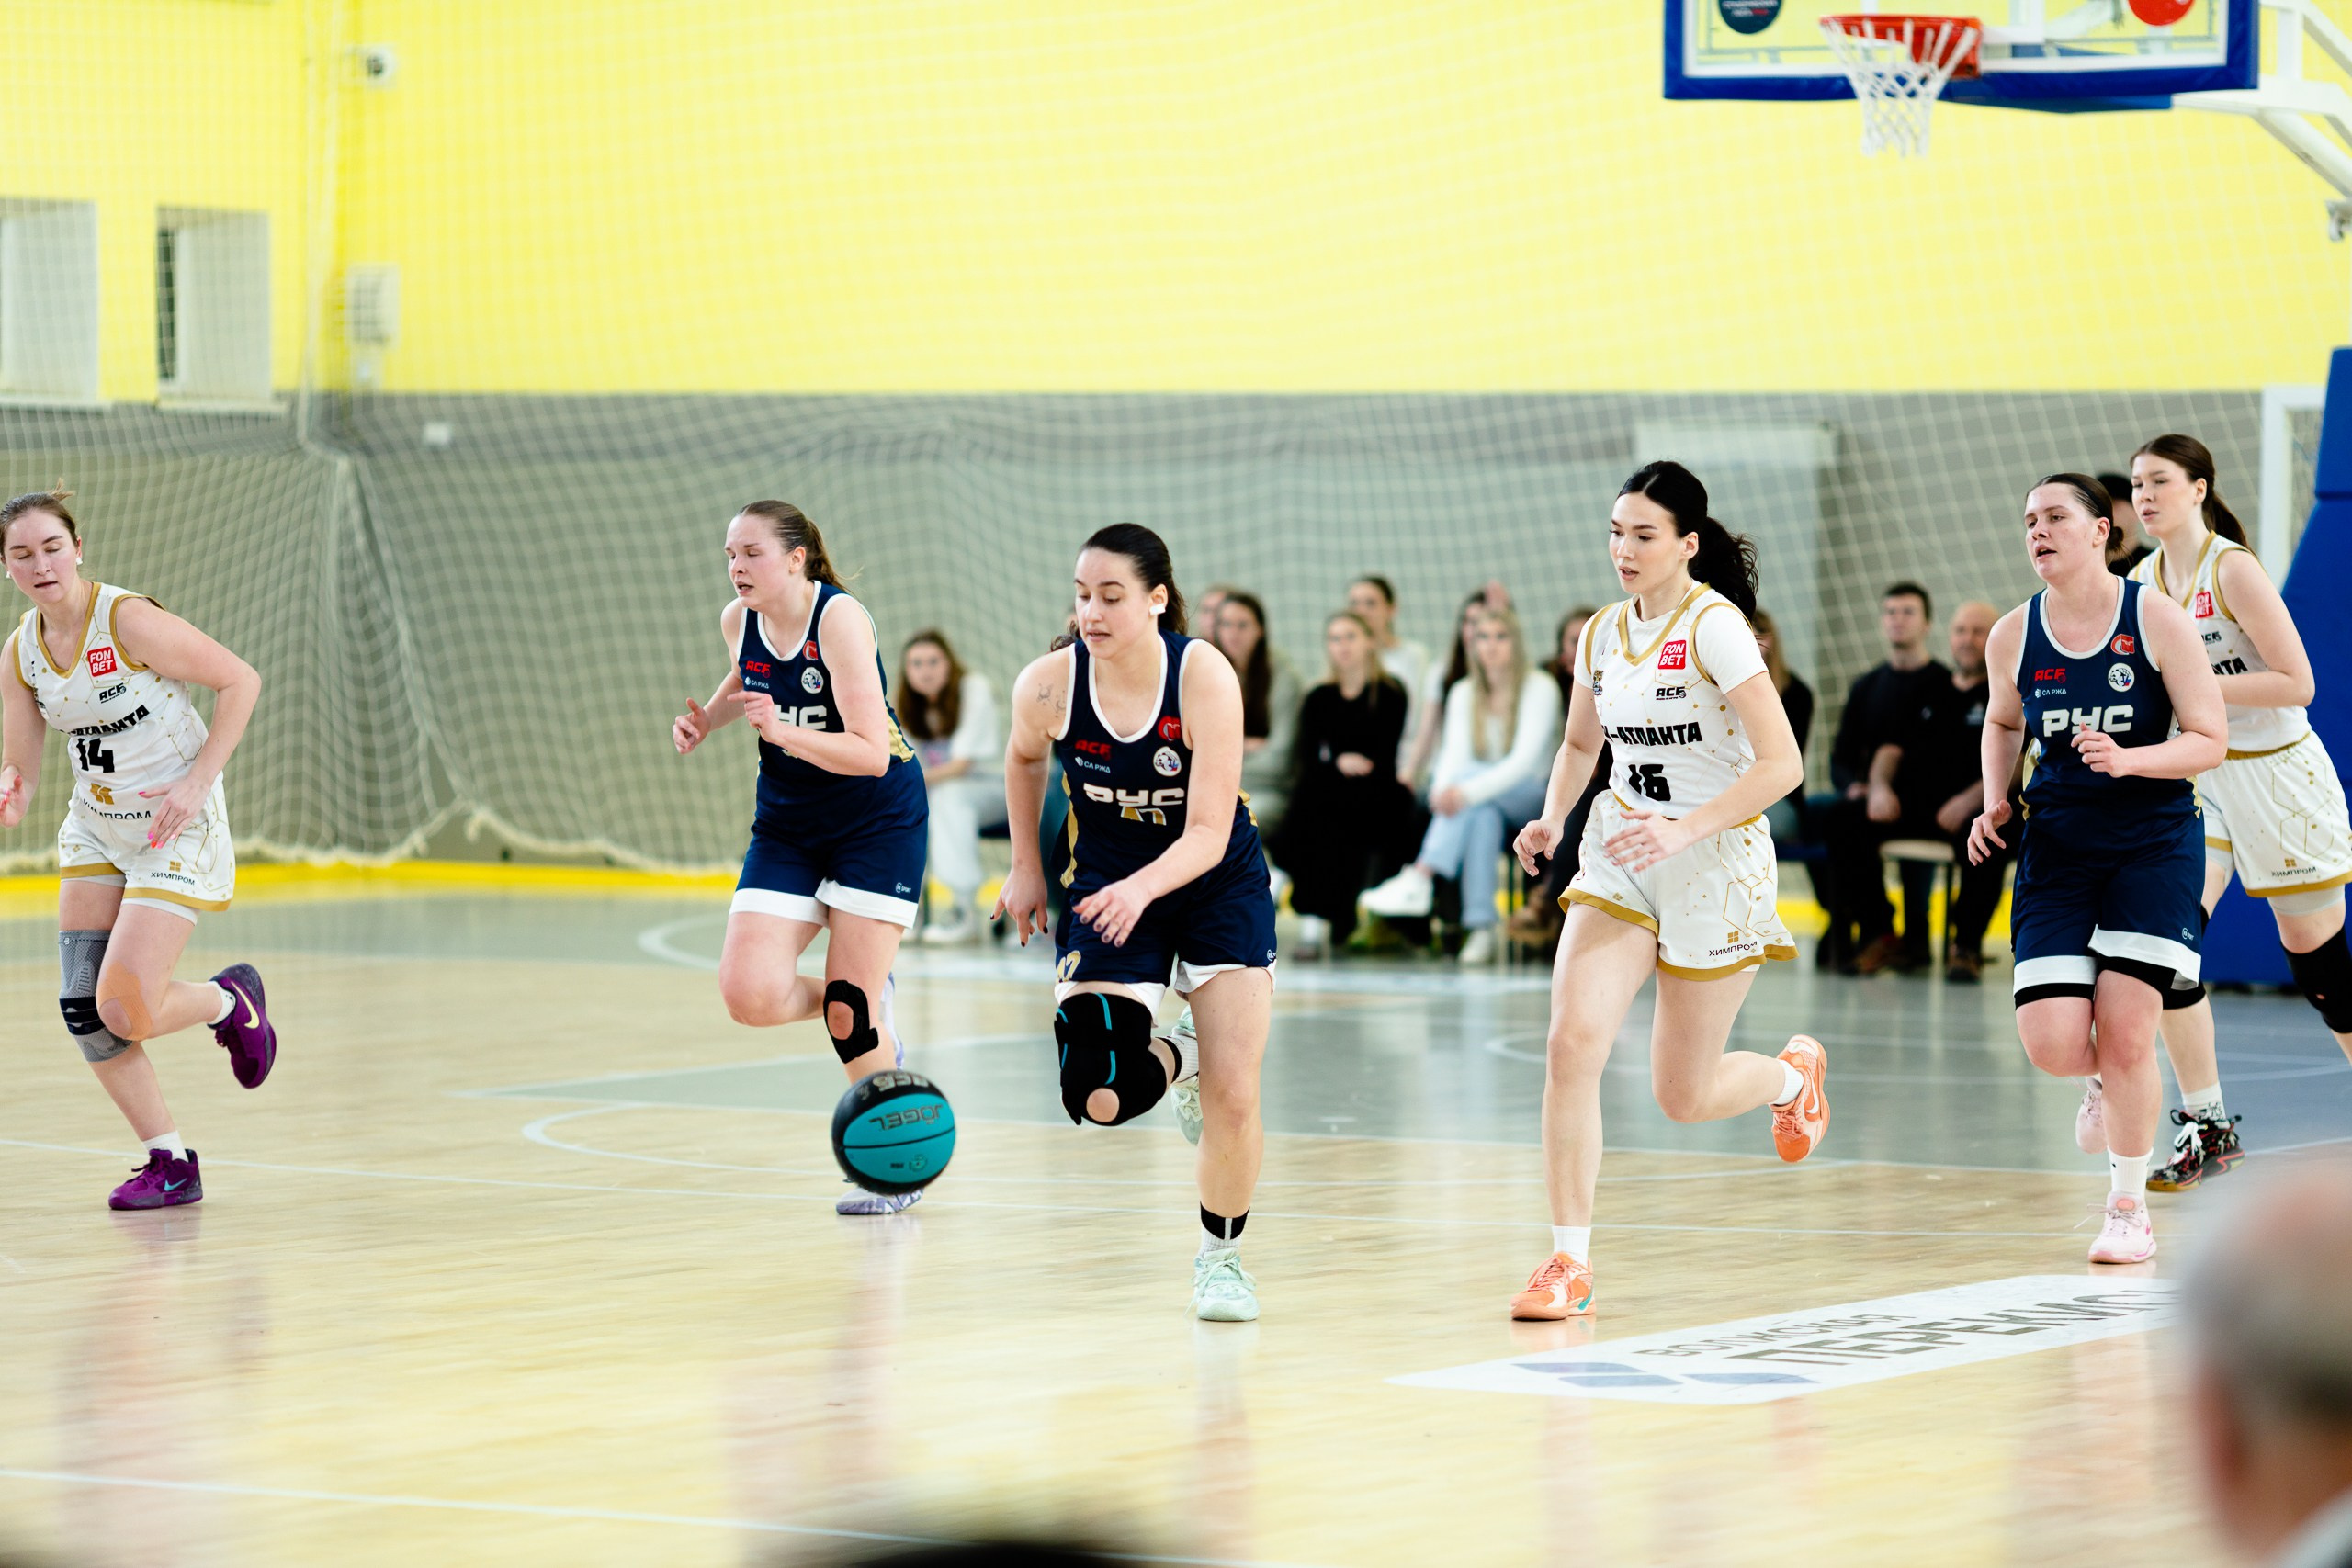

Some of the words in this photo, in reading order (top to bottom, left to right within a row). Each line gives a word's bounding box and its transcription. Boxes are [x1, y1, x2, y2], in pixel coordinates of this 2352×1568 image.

[2201, 631, 2222, 642] СБ
[90, 649, 111, 663] FON
[1663, 643, 1685, 655] FON
[92, 660, 113, 674] BET
[1659, 654, 1684, 666] BET
[774, 704, 827, 729] УС
[2042, 705, 2133, 737] РУС
[76, 738, 115, 773] 14
[1094, 764, 1111, 773] РЖД
[1628, 764, 1671, 801] 16
[151, 872, 195, 886] ХИМПРОМ
[1632, 1314, 1917, 1357] ВОЛЖСКАЯ
